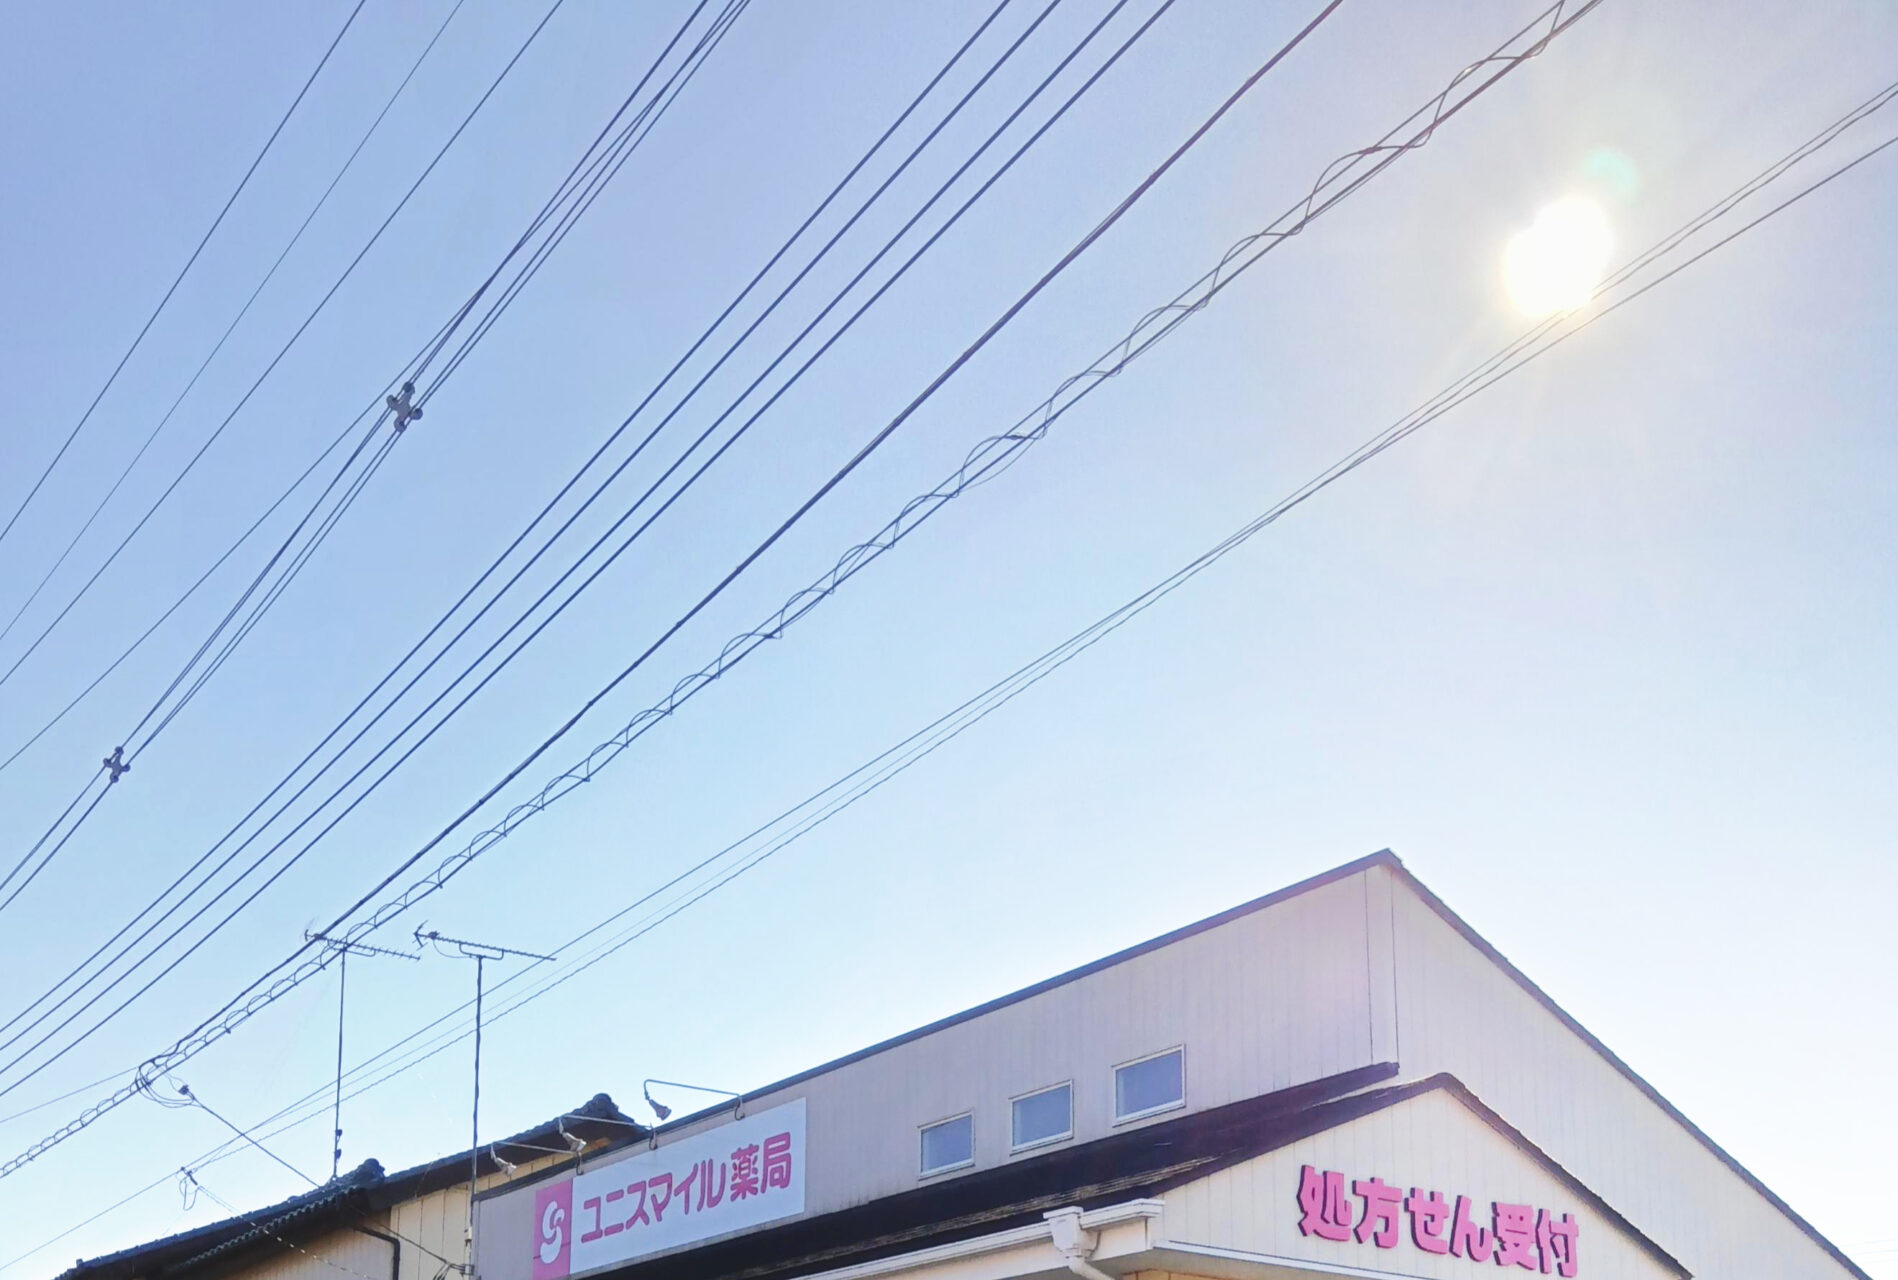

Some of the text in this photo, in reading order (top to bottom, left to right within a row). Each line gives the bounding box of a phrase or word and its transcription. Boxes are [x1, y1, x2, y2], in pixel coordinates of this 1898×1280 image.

[581, 1131, 791, 1243] ユニスマイル薬局
[1296, 1164, 1579, 1278] 処方せん受付
